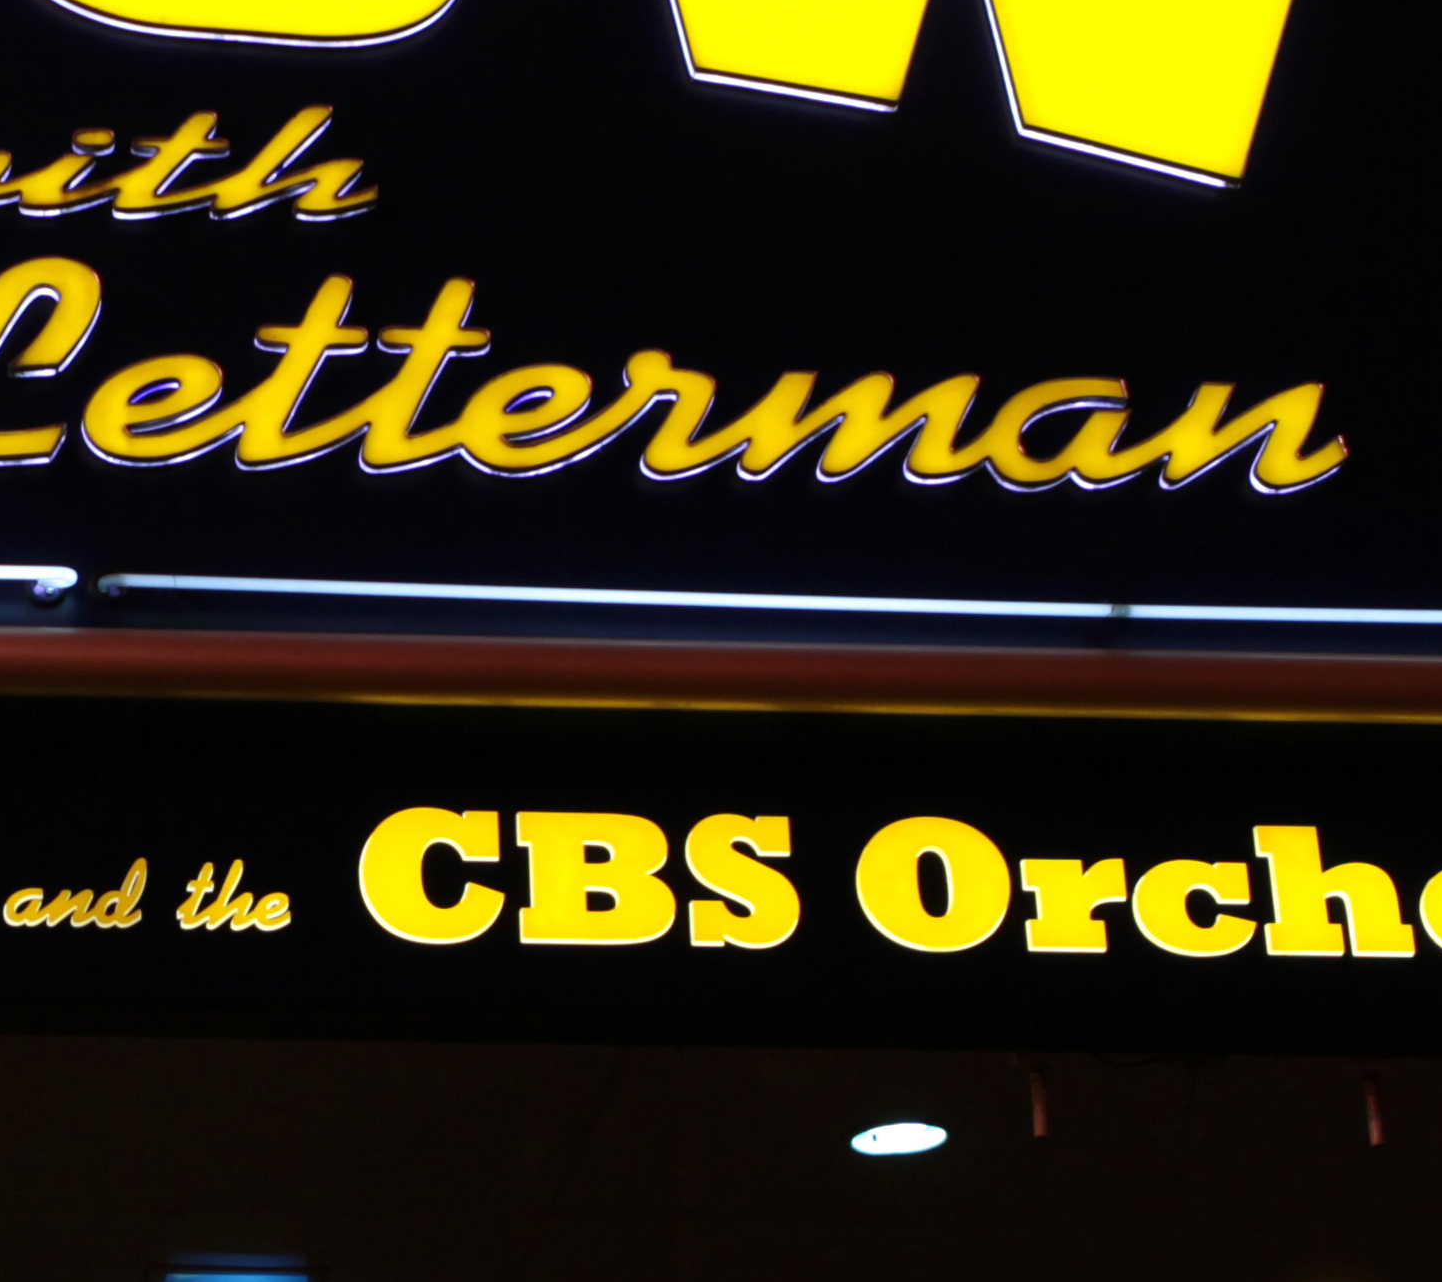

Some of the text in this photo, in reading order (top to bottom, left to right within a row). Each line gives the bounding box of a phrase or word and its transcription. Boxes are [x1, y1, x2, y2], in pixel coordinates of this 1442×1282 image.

[1, 857, 149, 931] and
[175, 858, 293, 933] the
[358, 805, 802, 951] CBS
